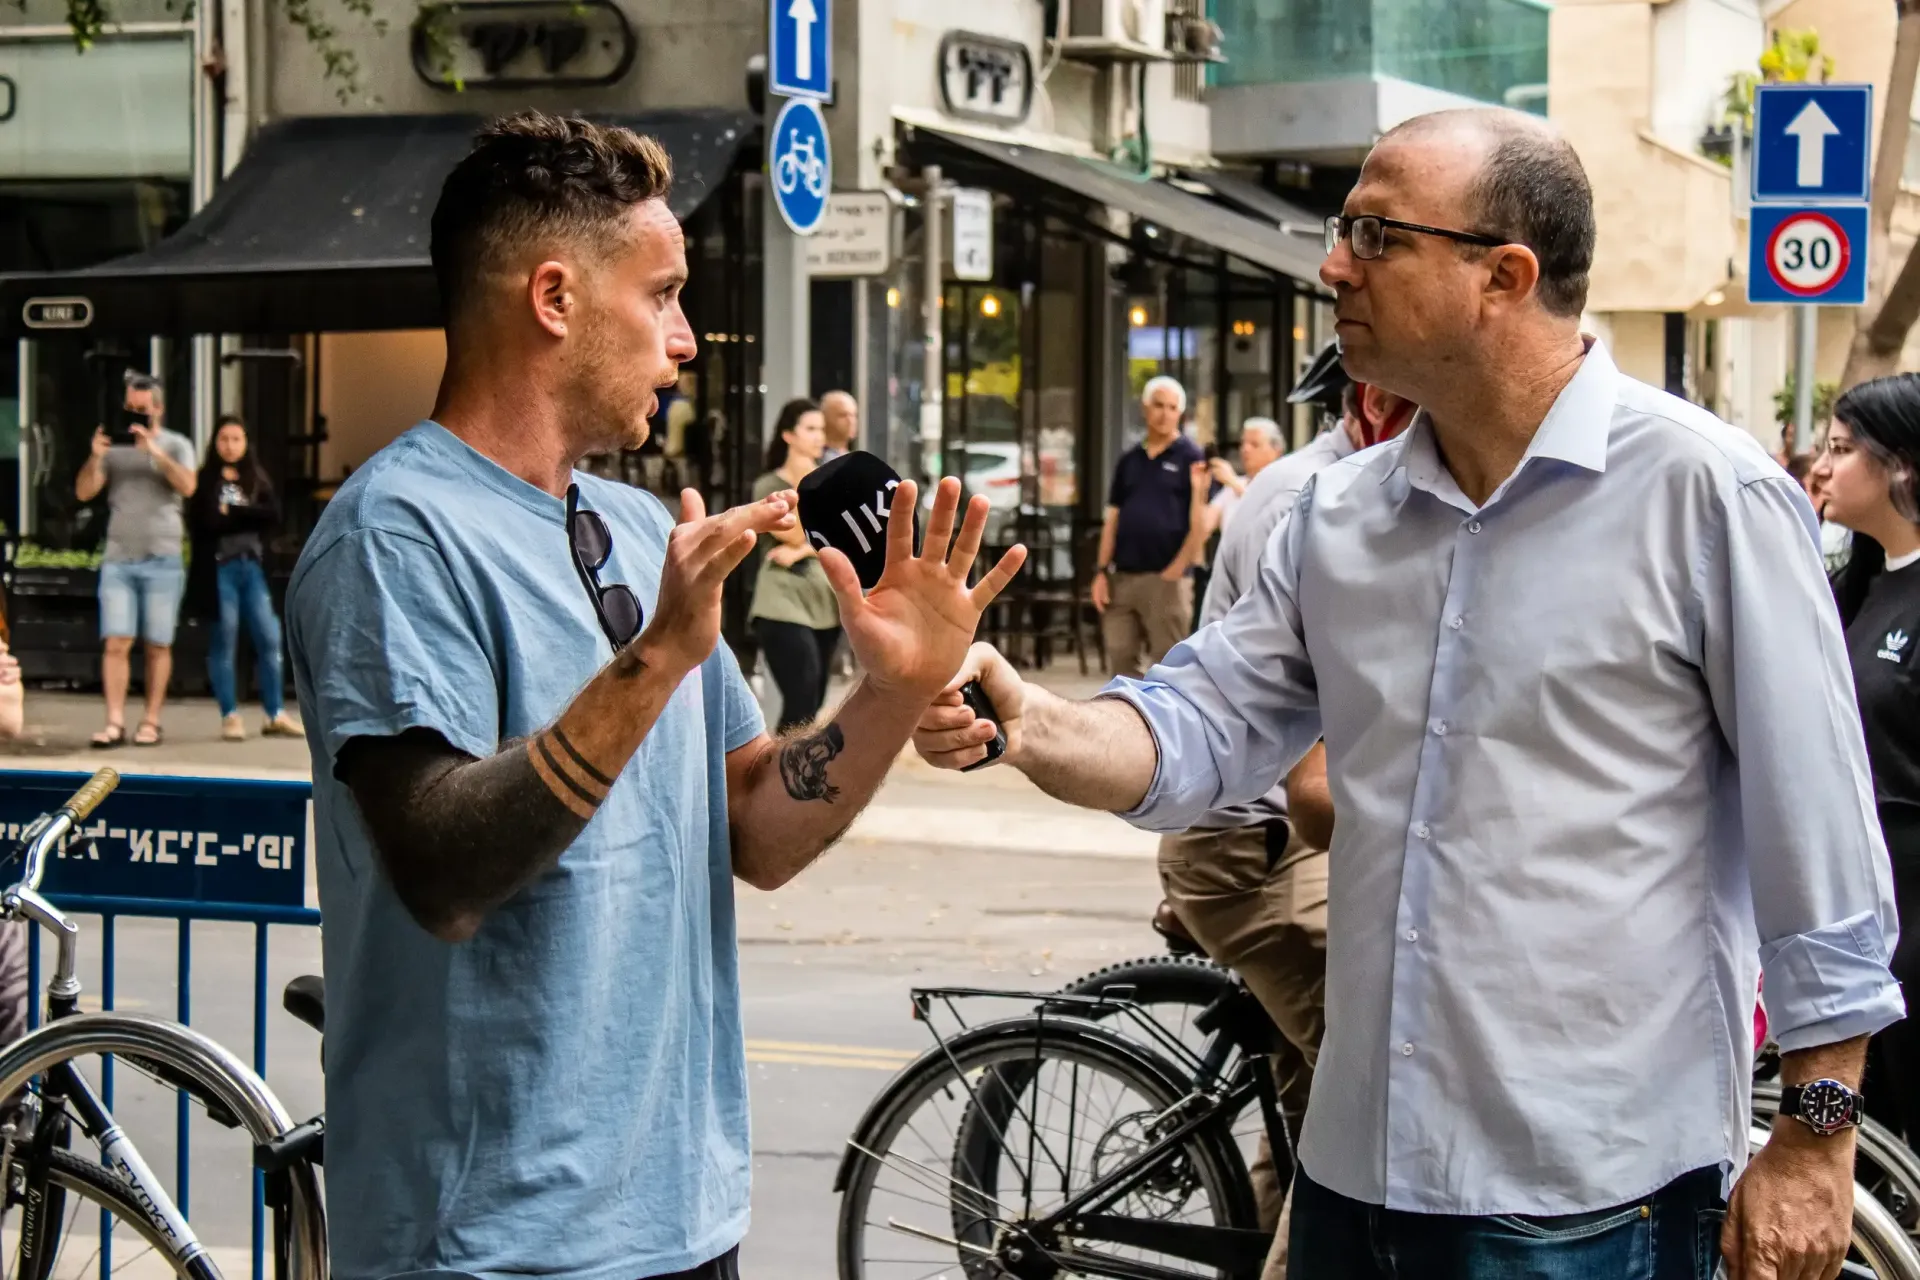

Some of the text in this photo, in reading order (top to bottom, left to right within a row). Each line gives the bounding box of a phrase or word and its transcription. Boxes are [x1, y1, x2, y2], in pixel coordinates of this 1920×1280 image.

[1783, 237, 1831, 271] 30
[20, 1187, 42, 1259] discovery
[117, 1157, 177, 1241] EVOKE
